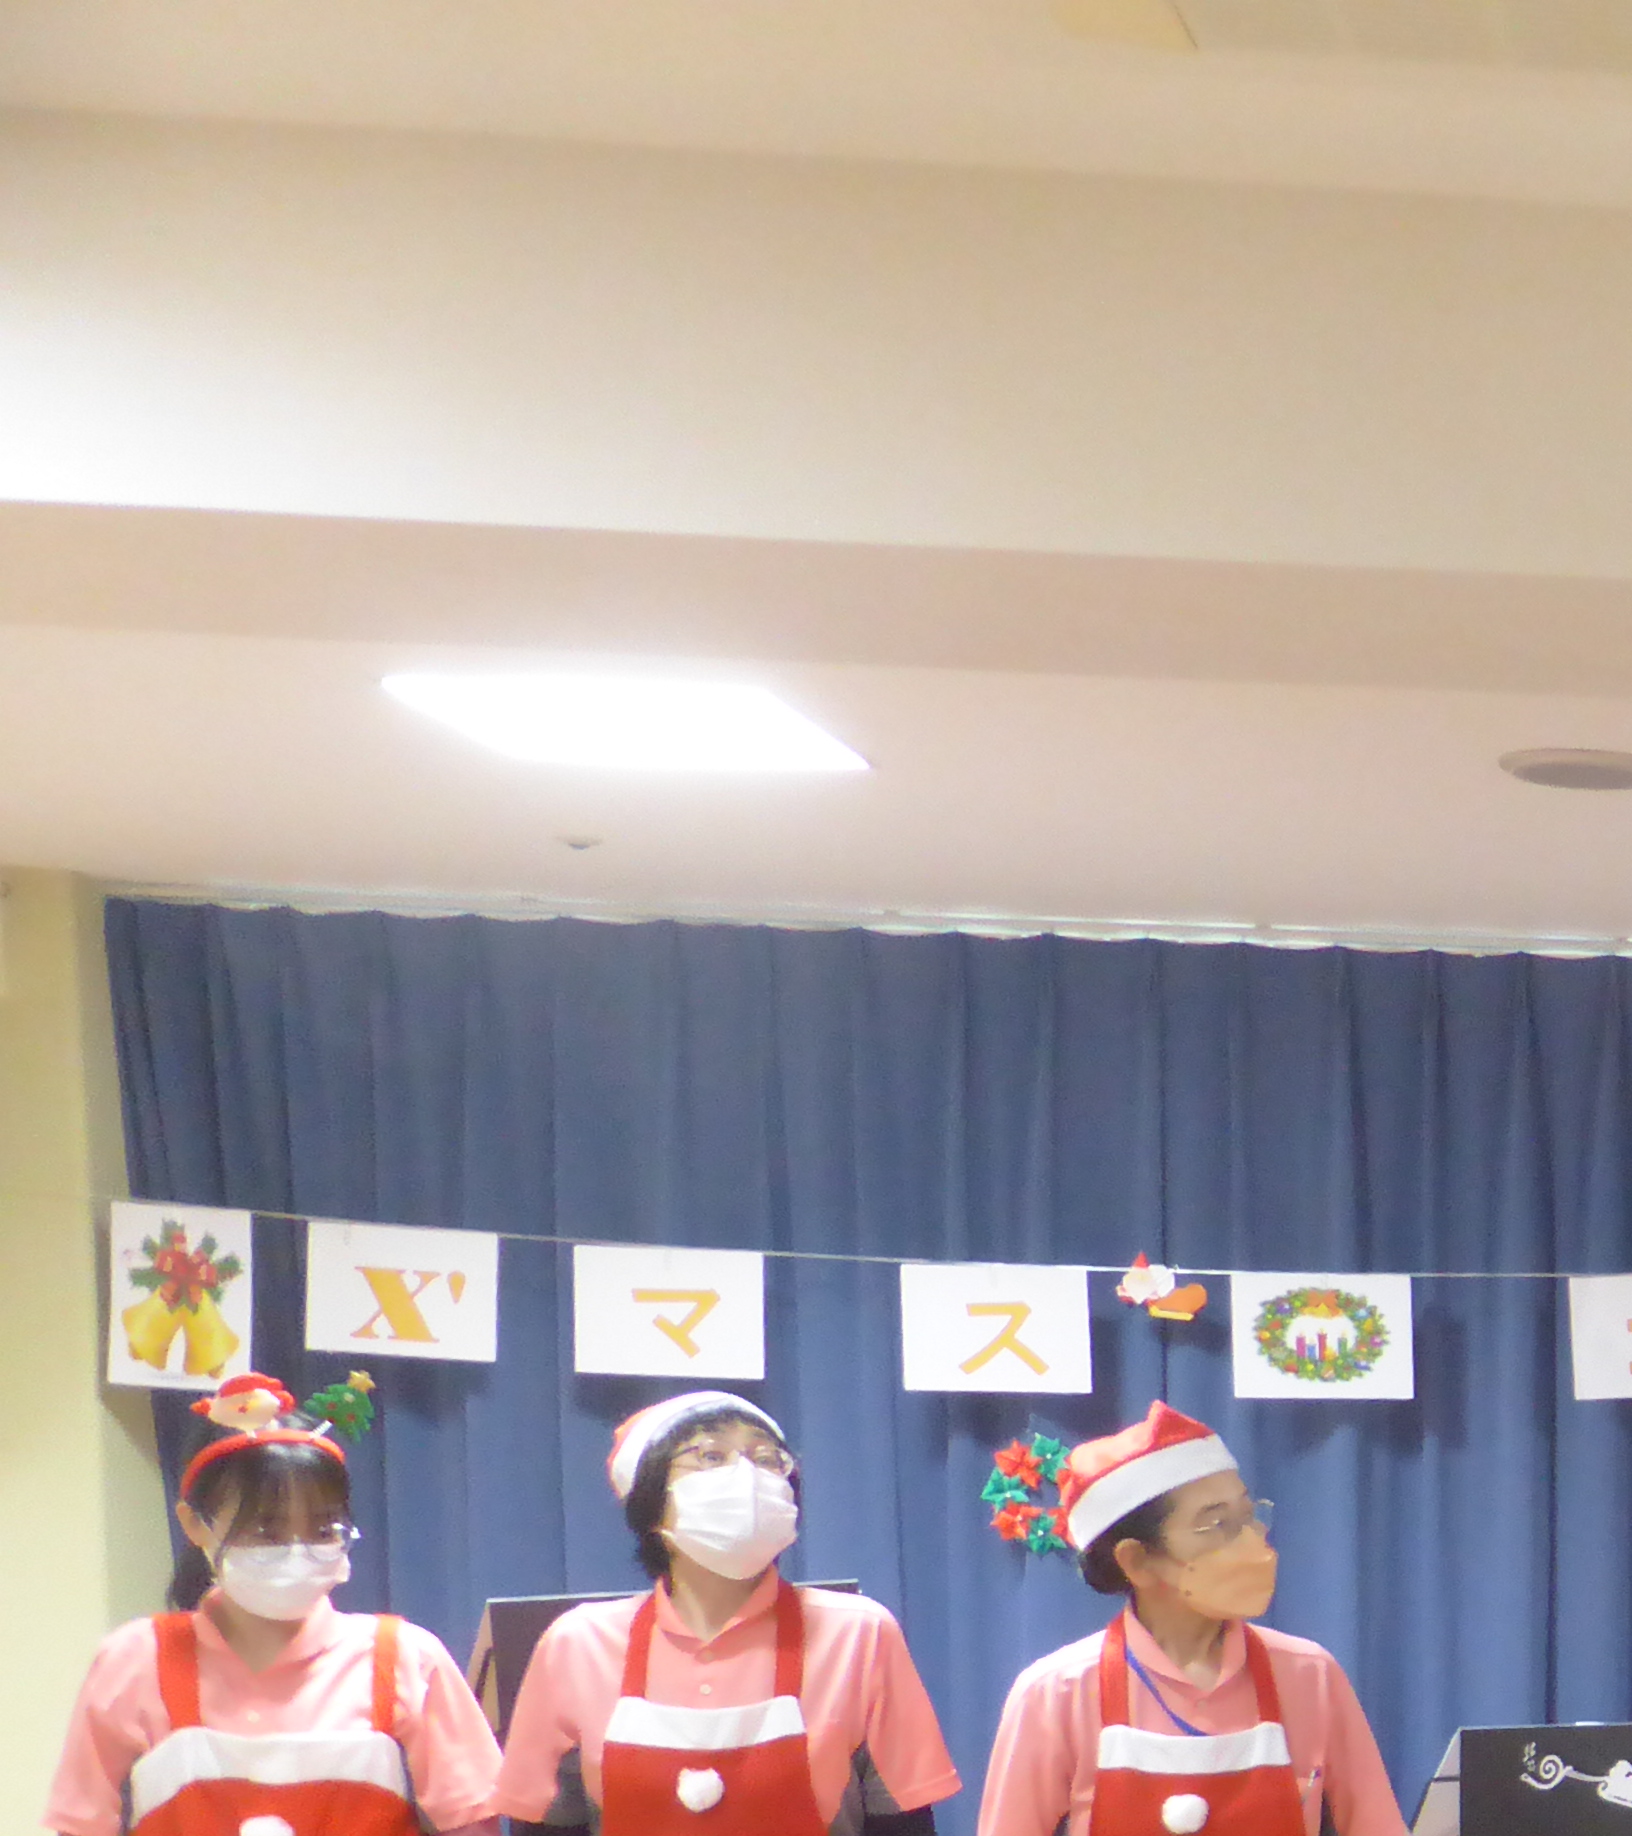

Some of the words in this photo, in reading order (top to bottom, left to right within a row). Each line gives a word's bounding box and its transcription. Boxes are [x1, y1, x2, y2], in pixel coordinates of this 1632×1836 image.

[351, 1266, 466, 1344] X'
[634, 1290, 720, 1358] マ
[961, 1302, 1048, 1376] ス
